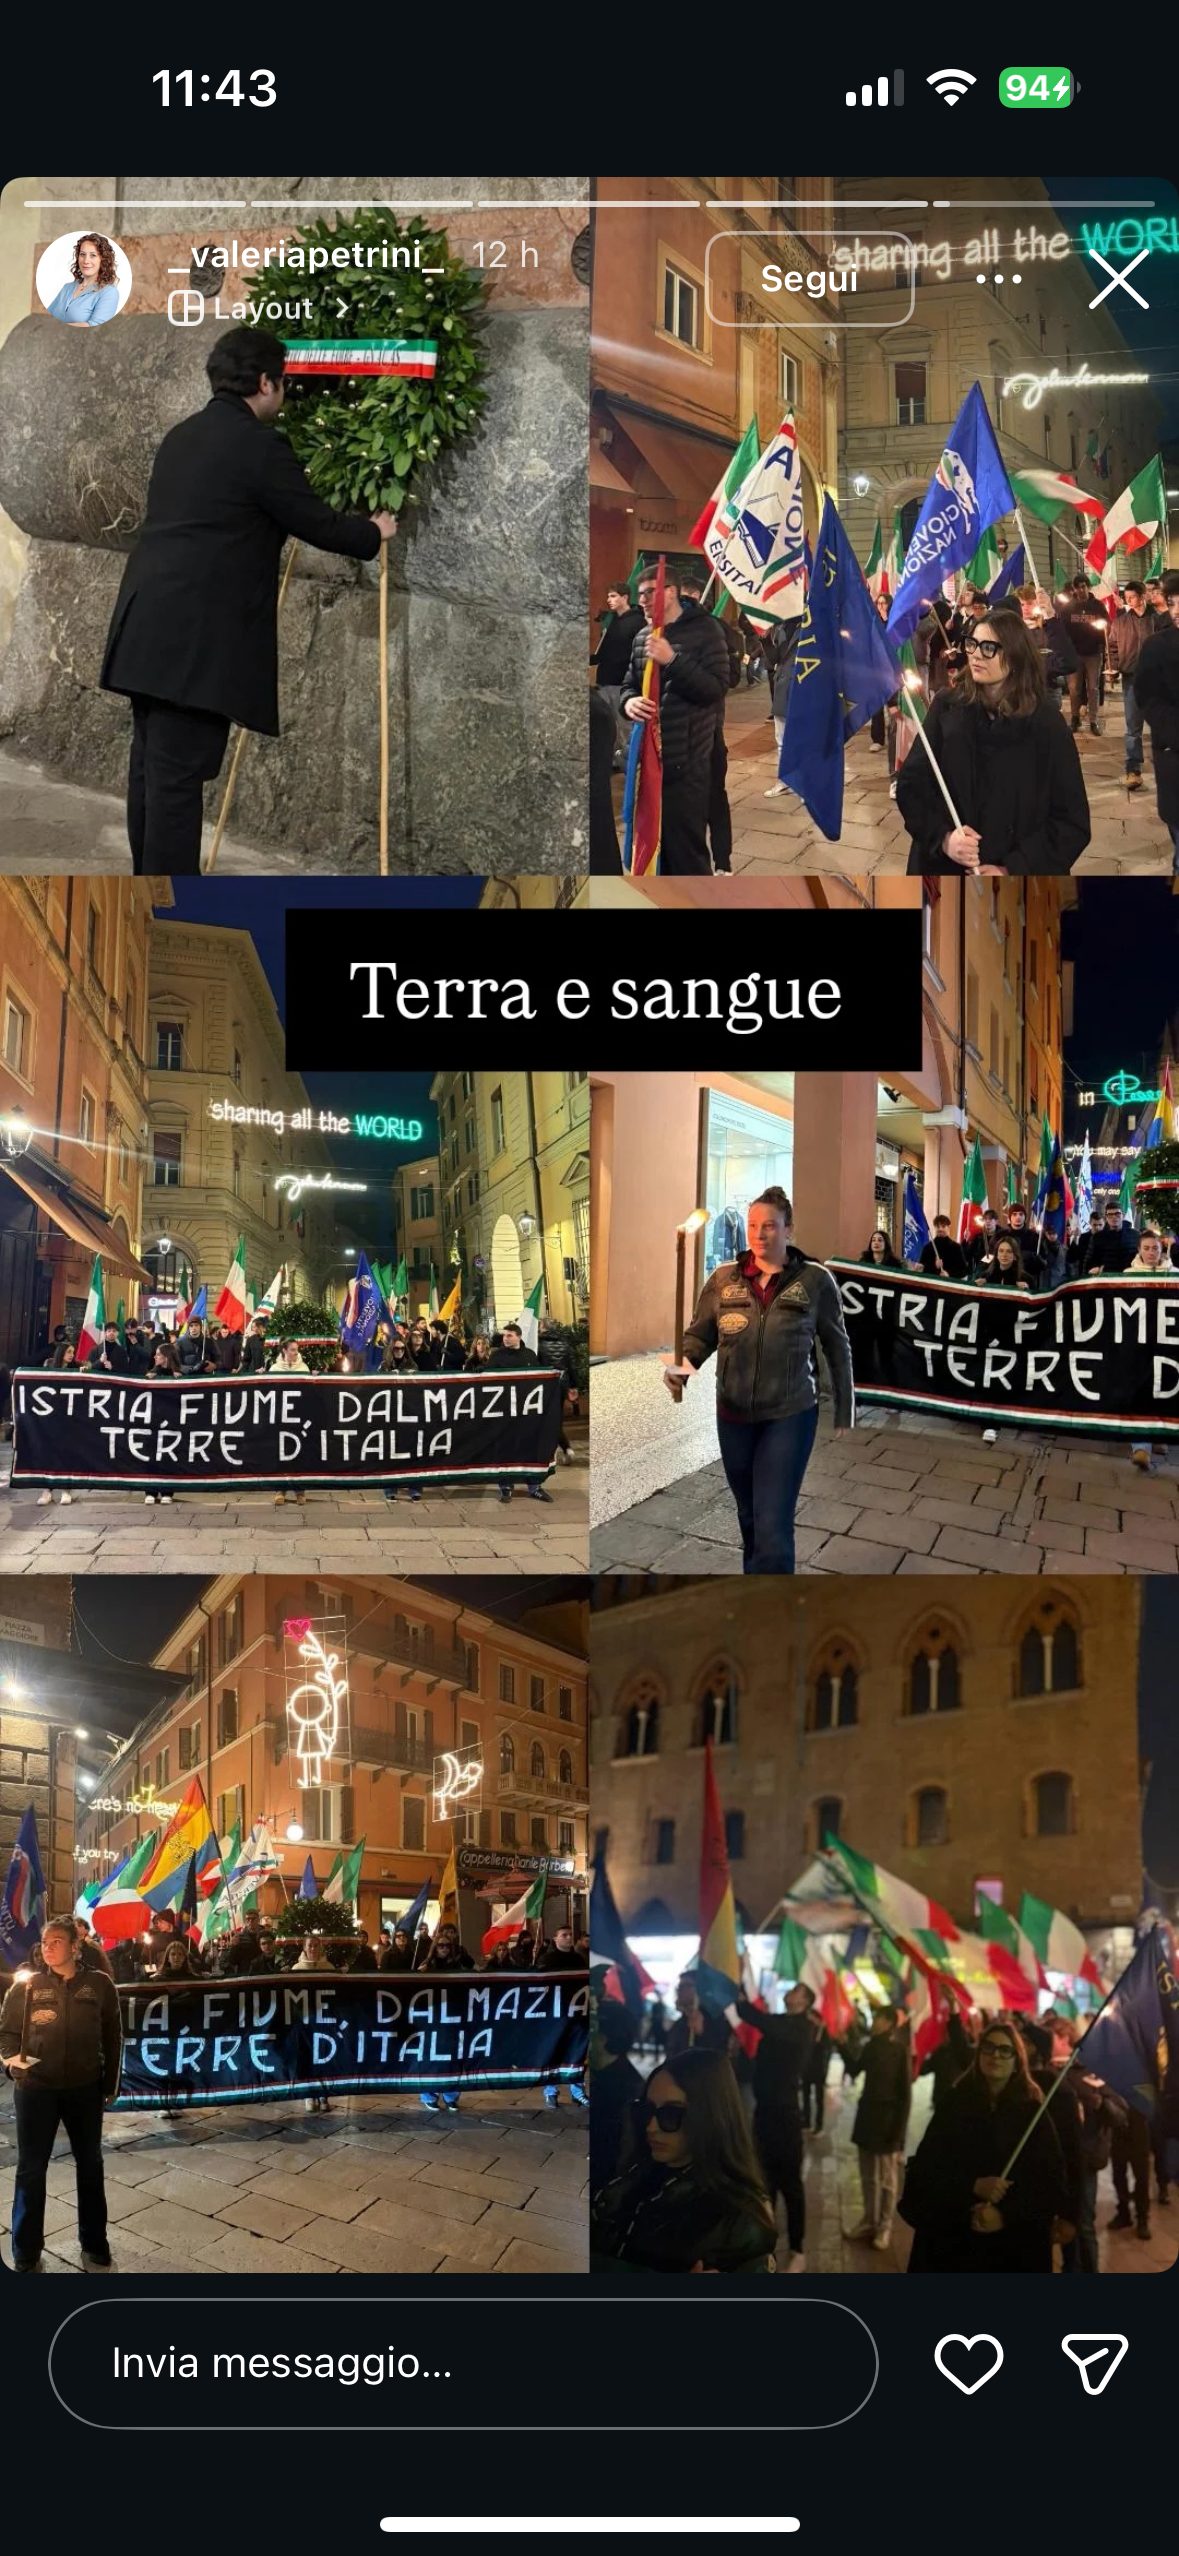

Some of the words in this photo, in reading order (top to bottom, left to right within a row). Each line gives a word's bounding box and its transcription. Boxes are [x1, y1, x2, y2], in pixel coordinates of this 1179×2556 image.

[964, 228, 999, 264] all
[1014, 225, 1070, 262] the
[290, 1108, 311, 1130] all
[319, 1111, 350, 1134] the
[354, 1114, 423, 1141] WORLD
[914, 1340, 1103, 1401] TERRE
[338, 1384, 544, 1423] DALMAZIA
[100, 1427, 245, 1465] TERRE
[278, 1428, 452, 1461] D'ITALIA
[376, 1985, 589, 2025] DALMAZIA
[312, 2027, 494, 2066] D'ITALIA
